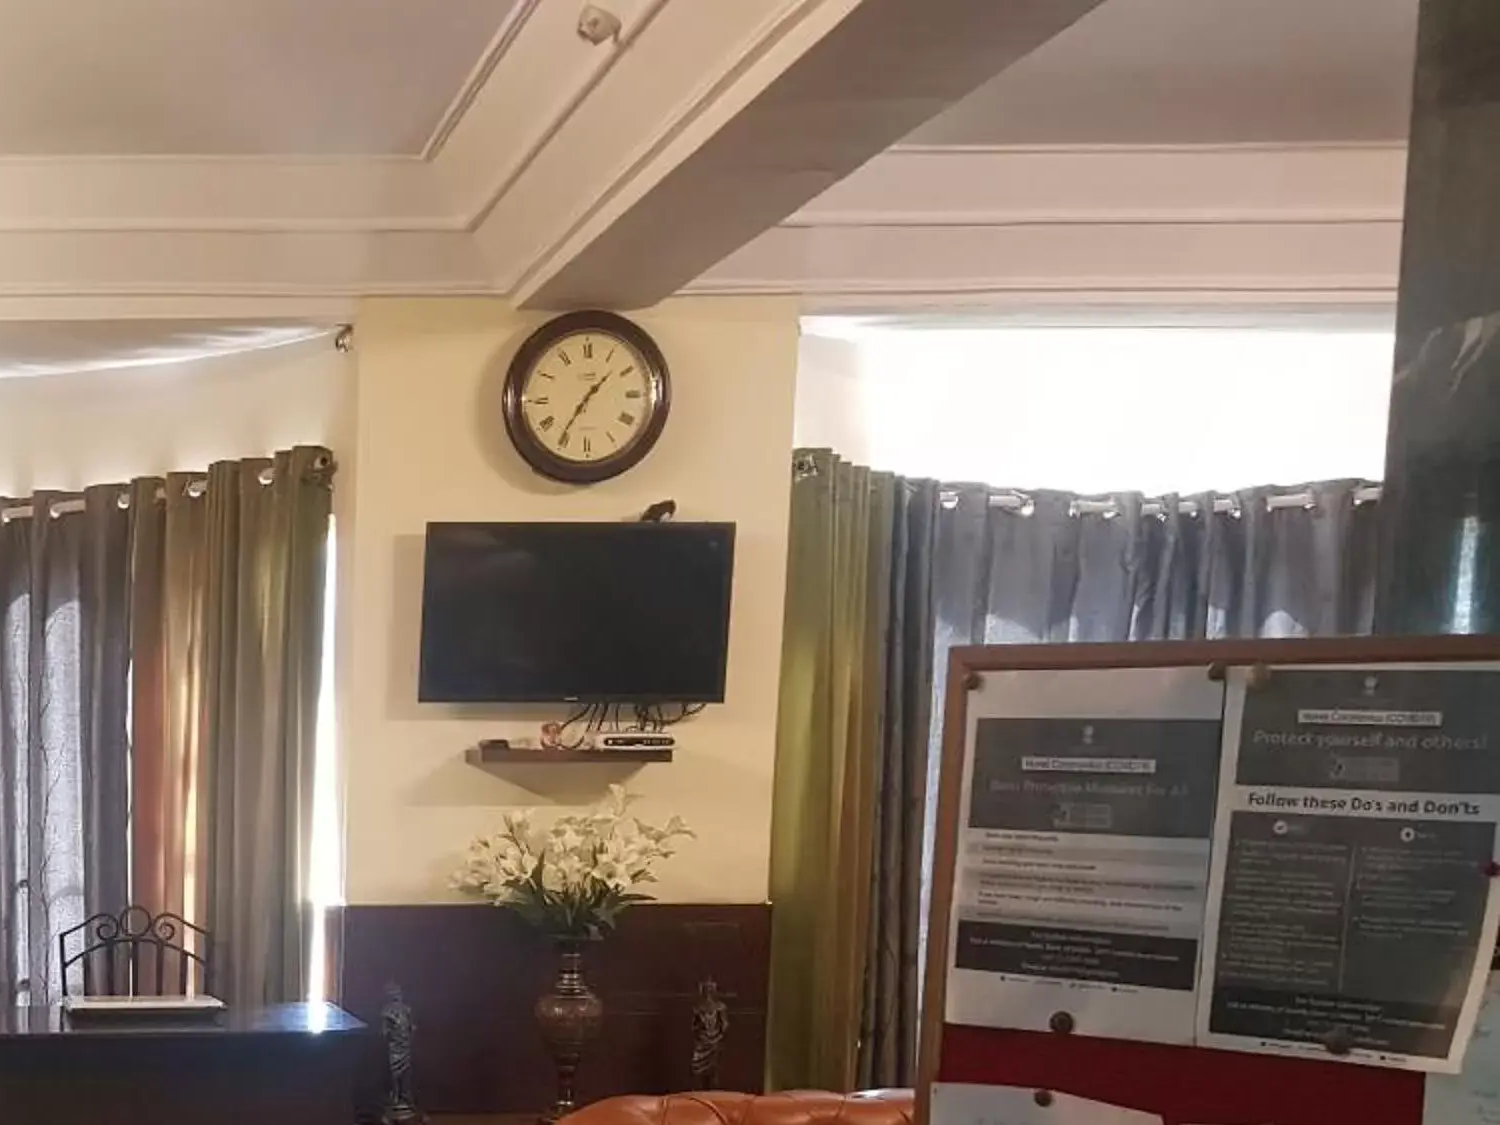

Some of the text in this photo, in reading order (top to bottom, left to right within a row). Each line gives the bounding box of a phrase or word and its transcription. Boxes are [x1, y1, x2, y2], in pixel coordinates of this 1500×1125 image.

[1252, 729, 1312, 745] Protect
[1316, 730, 1383, 748] yourself
[1385, 732, 1417, 749] and
[1247, 791, 1299, 807] Follow
[1302, 794, 1347, 810] these
[1386, 798, 1419, 814] and
[1422, 799, 1481, 816] Don'ts
